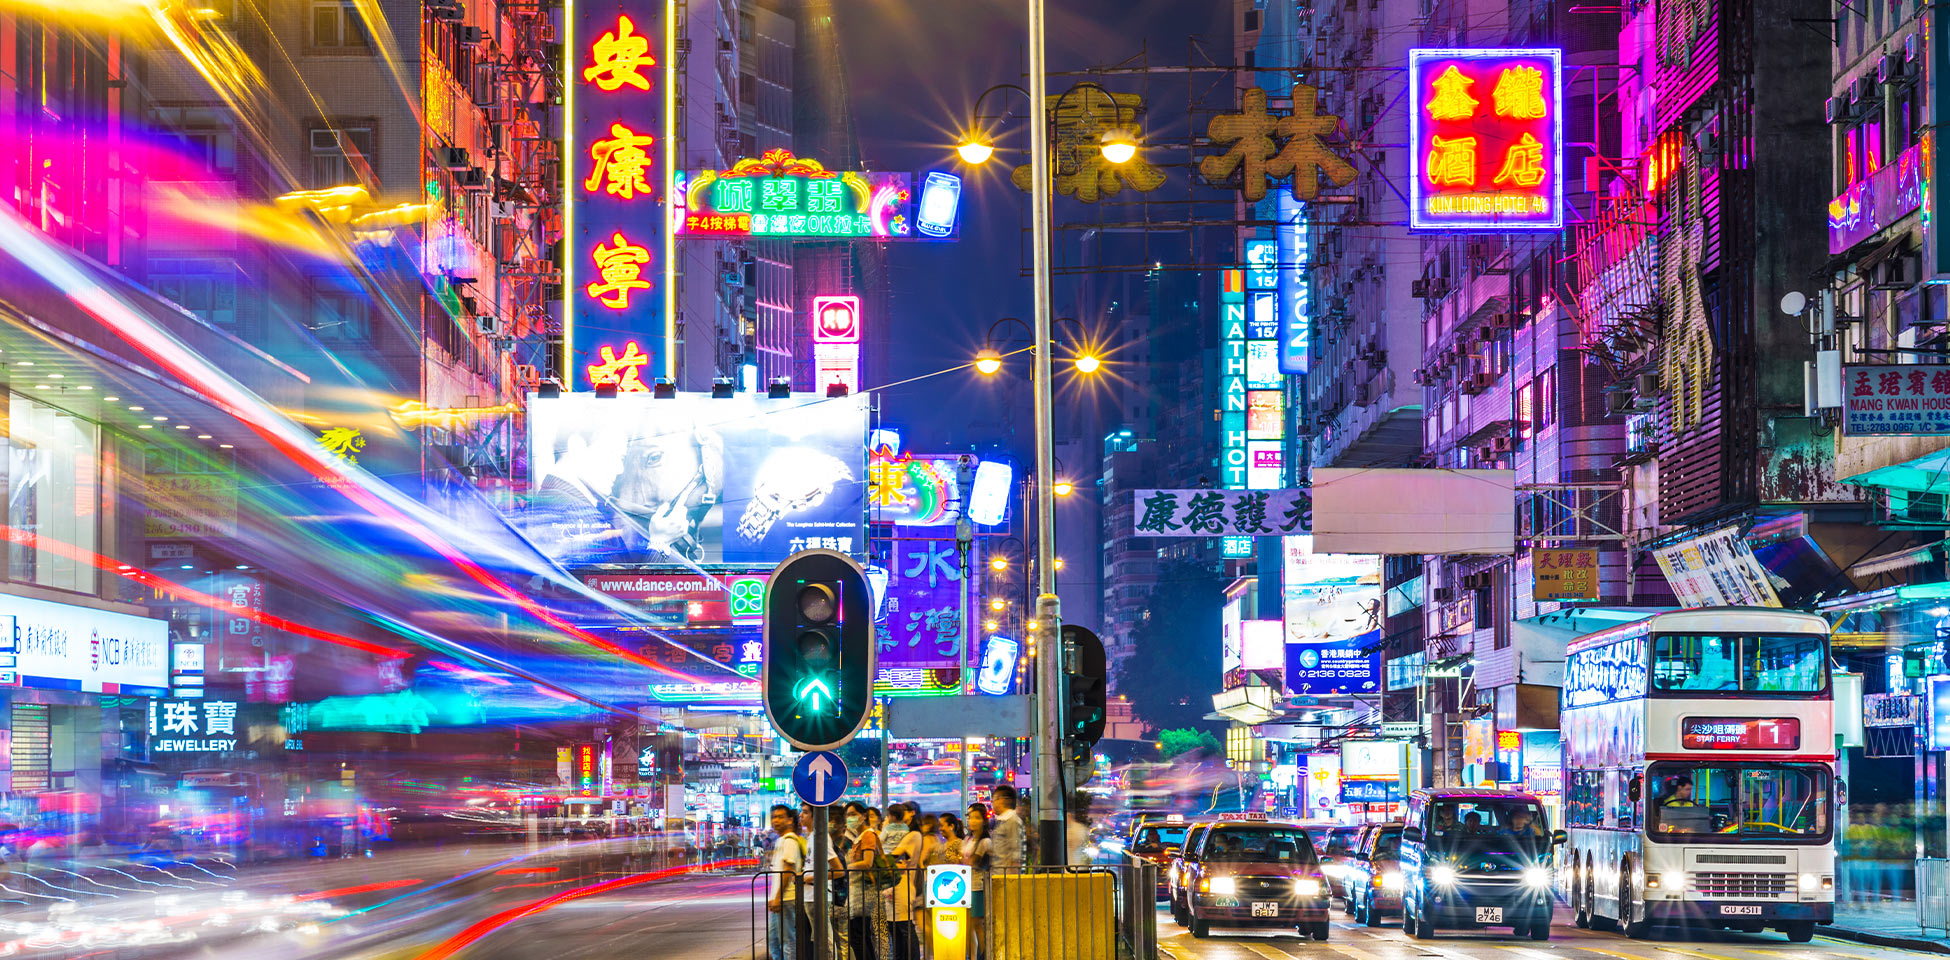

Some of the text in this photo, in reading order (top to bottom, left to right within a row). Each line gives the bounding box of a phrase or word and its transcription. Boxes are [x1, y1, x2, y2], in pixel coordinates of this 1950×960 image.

[1428, 132, 1547, 186] 酒店
[1429, 197, 1453, 213] KUM
[1456, 197, 1491, 213] LOONG
[1495, 197, 1529, 213] HOTEL
[1227, 305, 1246, 490] NATHAN HOT
[1850, 399, 1883, 411] MANG
[1887, 399, 1918, 411] KWAN
[1851, 422, 1890, 432] TEL:2783
[1893, 422, 1914, 431] 0967
[1223, 540, 1251, 554] 酒店
[601, 577, 722, 592] www.dance.com.hk
[1563, 581, 1588, 591] 命名
[228, 583, 251, 635] 富田
[102, 638, 120, 665] NCB
[1307, 670, 1371, 678] 2136 0828
[150, 696, 238, 736] 珠寶
[1696, 735, 1741, 743] STAR FERRY
[1769, 725, 1780, 744] 1
[155, 739, 237, 751] JEWELLERY
[1220, 813, 1247, 821] TAXI
[1483, 907, 1496, 915] MX
[1724, 906, 1758, 914] GU 4511
[1477, 914, 1501, 922] 2746
